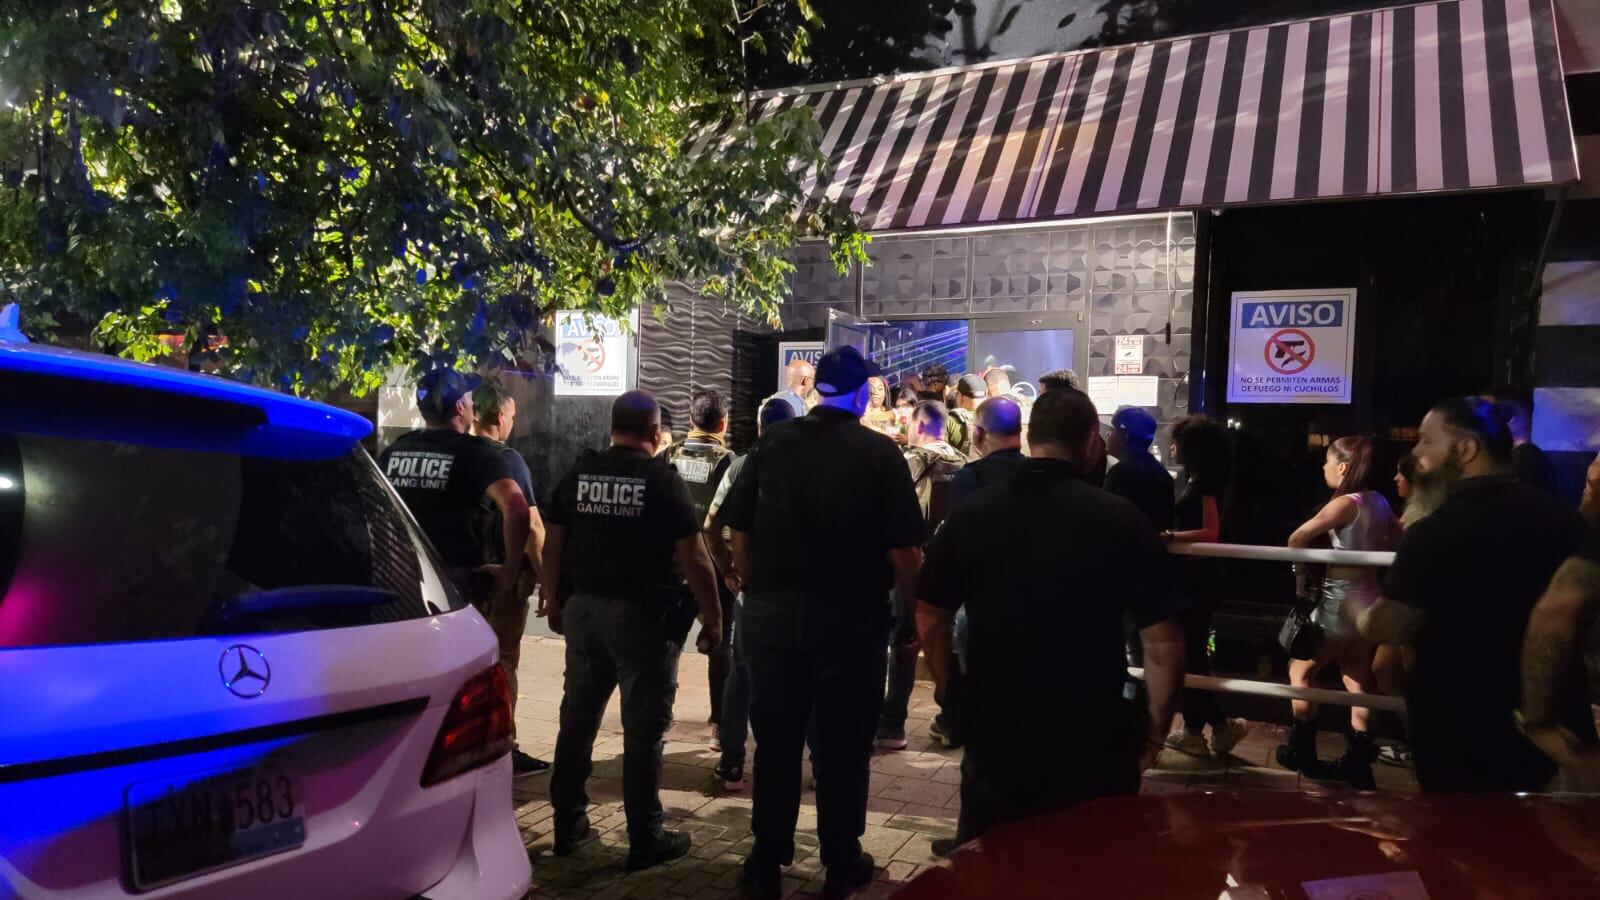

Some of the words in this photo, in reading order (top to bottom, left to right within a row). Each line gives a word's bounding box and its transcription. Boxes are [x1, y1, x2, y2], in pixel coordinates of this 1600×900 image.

[1249, 303, 1336, 326] AVISO
[567, 318, 617, 337] AVO
[789, 351, 824, 366] AVIS
[1254, 385, 1281, 393] FUEGO
[1294, 385, 1339, 393] CUCHILLOS
[386, 457, 453, 479] POLICE
[420, 479, 448, 489] UNIT
[576, 480, 646, 506] POLICE
[576, 502, 611, 515] GANG
[614, 506, 643, 518] UNIT
[235, 774, 294, 830] 583
